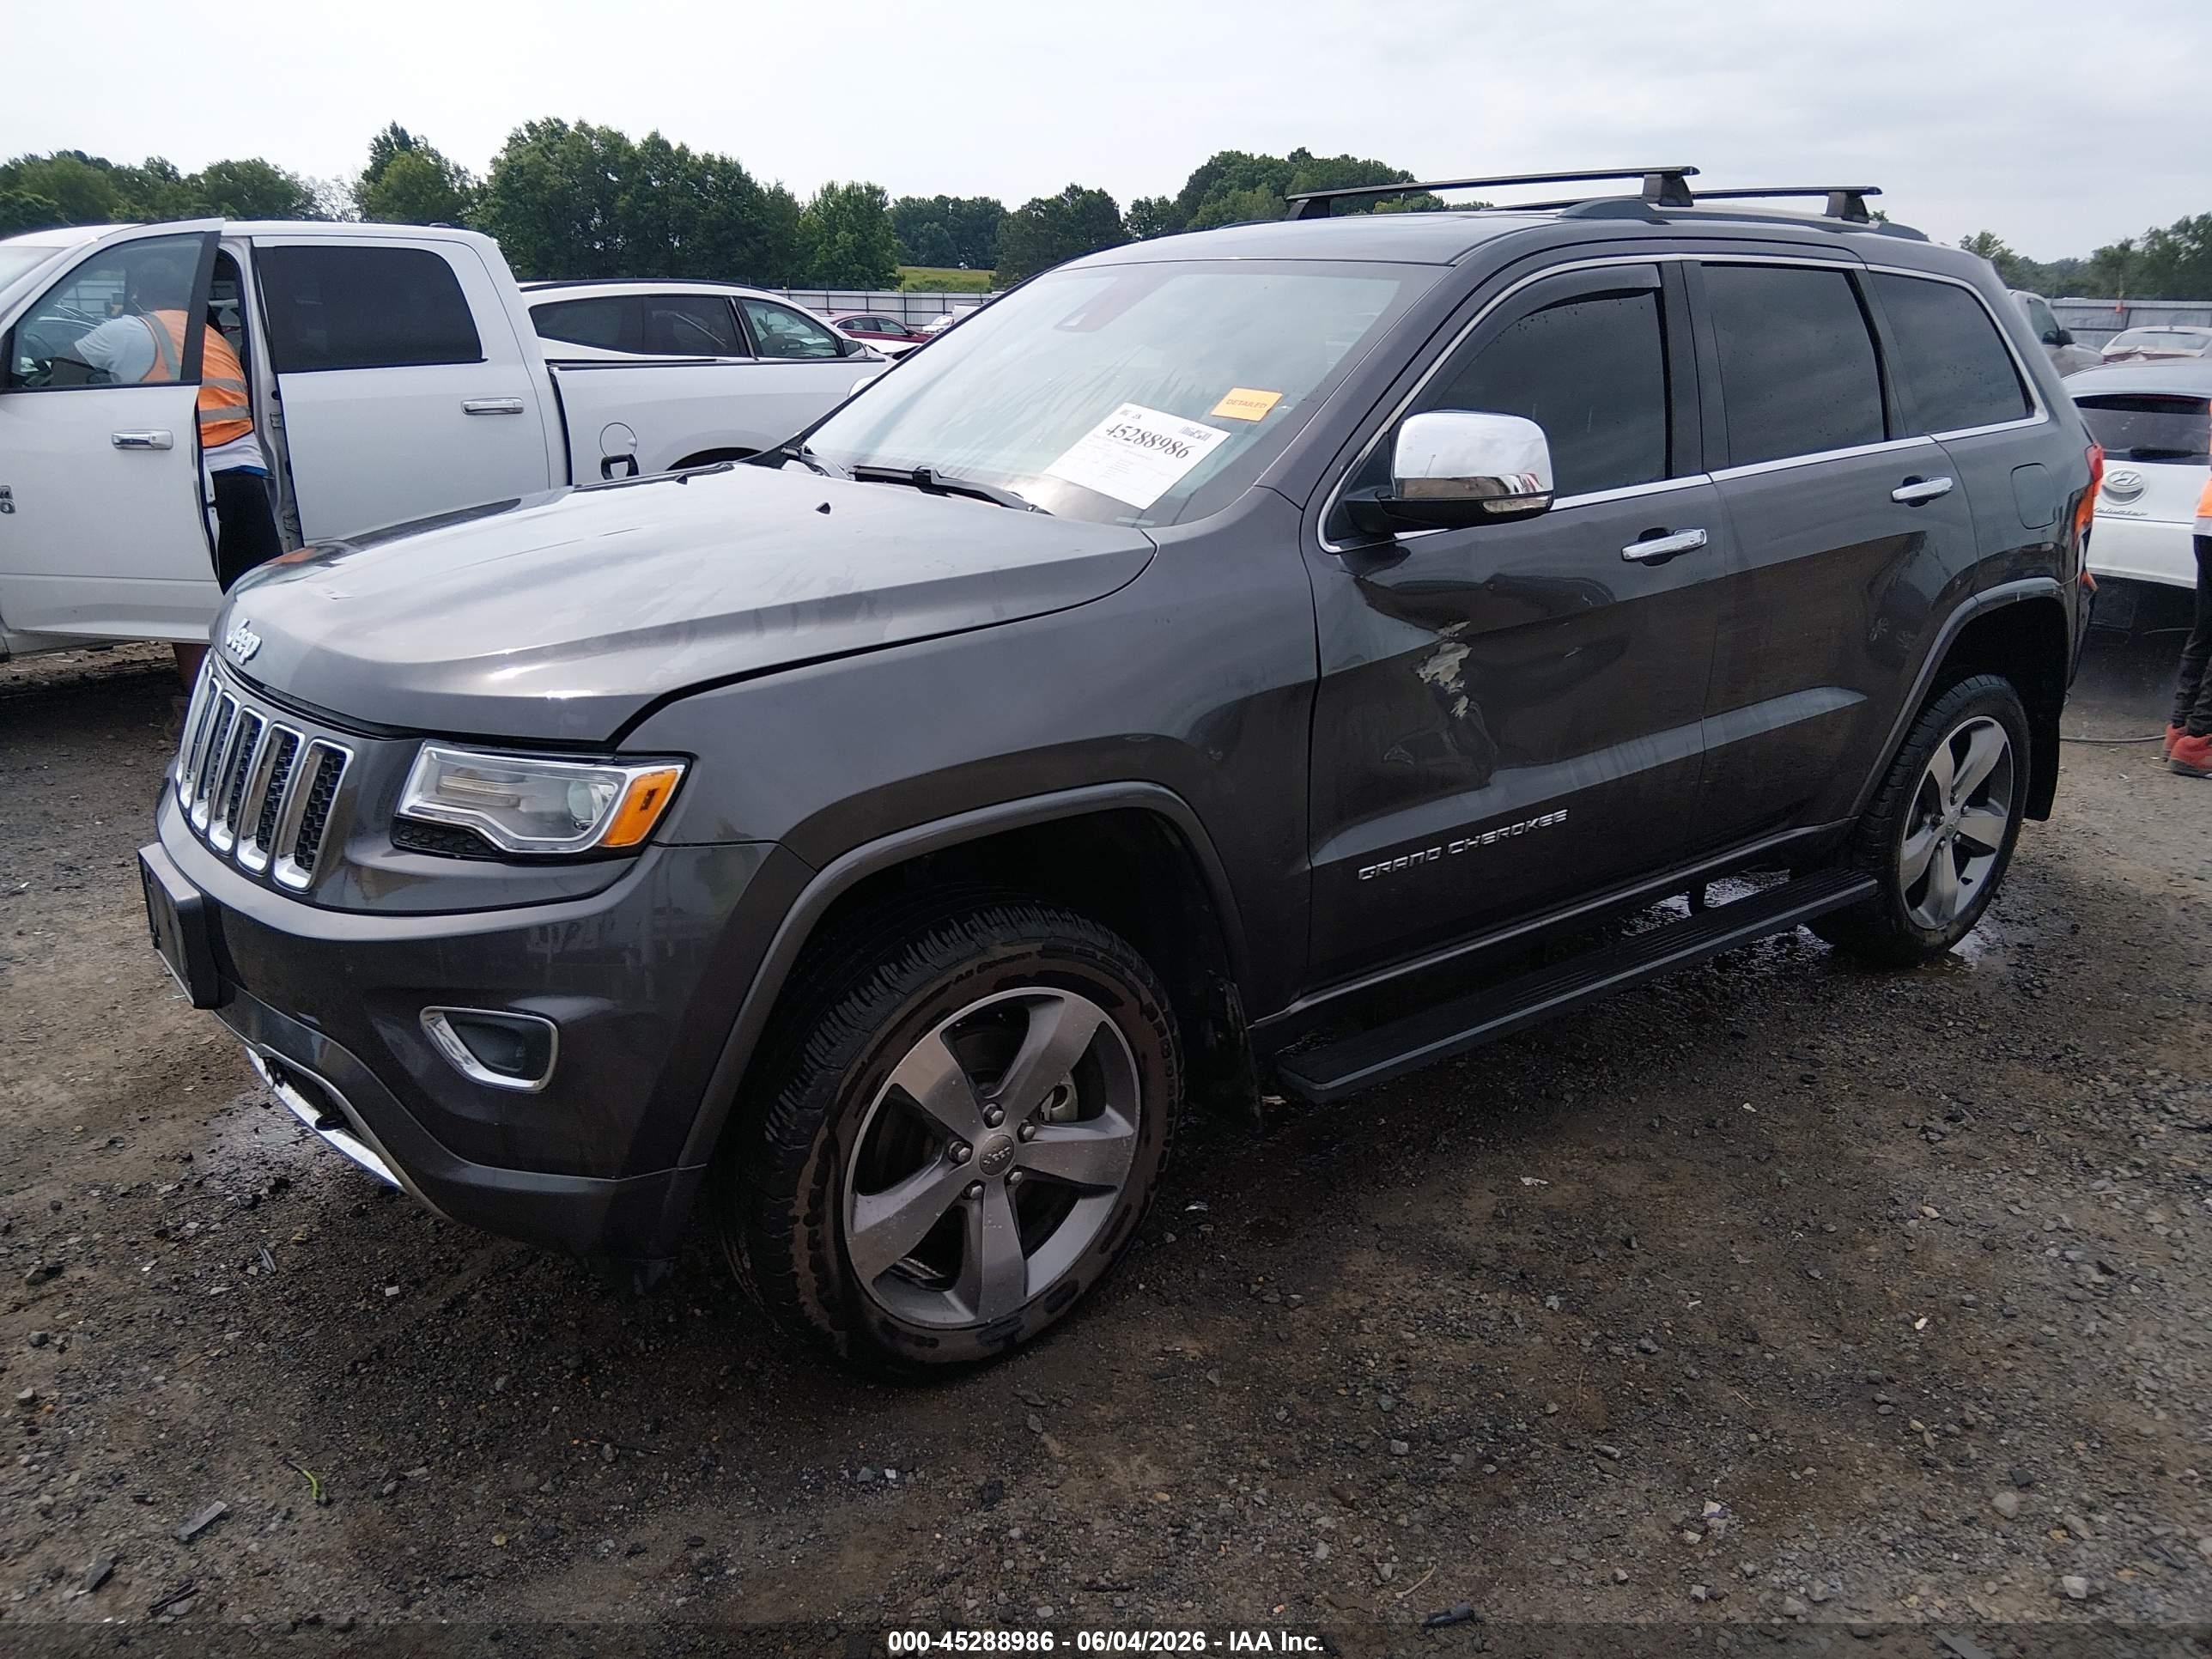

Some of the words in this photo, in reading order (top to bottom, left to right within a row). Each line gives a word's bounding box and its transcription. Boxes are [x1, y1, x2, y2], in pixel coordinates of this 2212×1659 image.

[1225, 398, 1267, 409] DETAILED
[1106, 422, 1195, 459] 45288986
[226, 617, 262, 665] Jeep
[1358, 847, 1442, 880] GRAND
[1448, 809, 1568, 854] CHEROKEE
